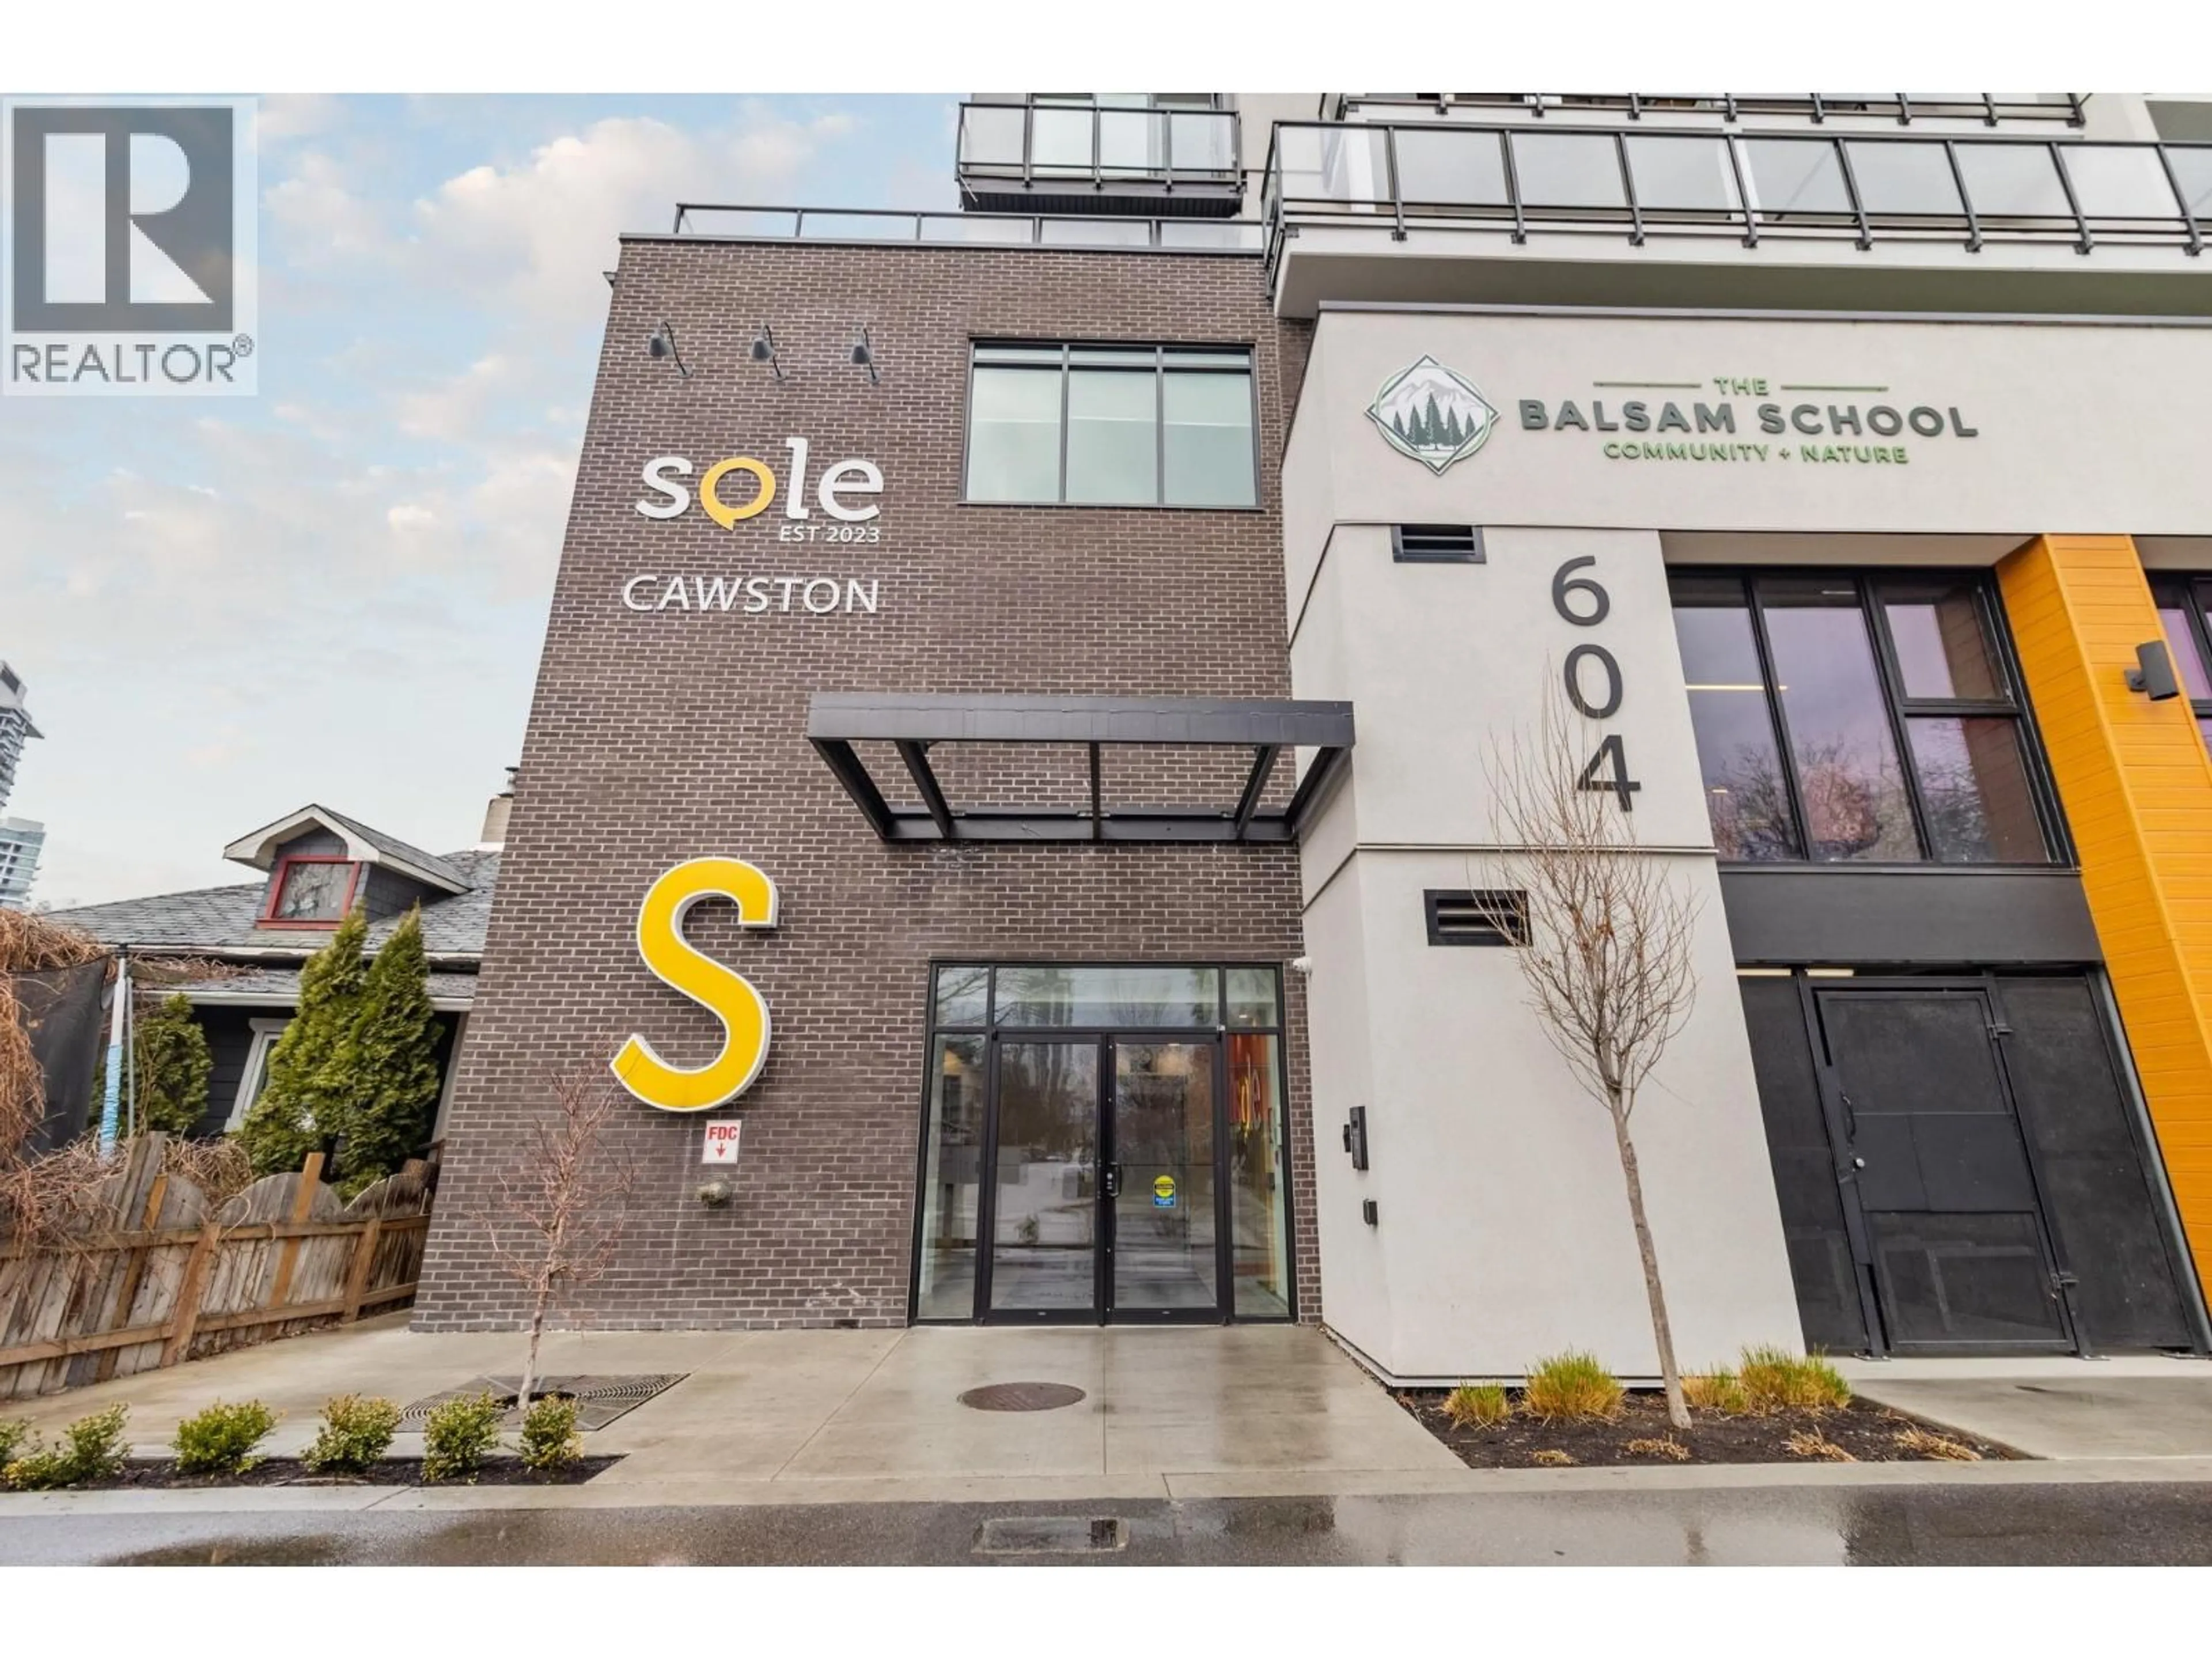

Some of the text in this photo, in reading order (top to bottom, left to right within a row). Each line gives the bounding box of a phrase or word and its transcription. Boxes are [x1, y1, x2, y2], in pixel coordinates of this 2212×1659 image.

[1713, 377, 1770, 396] THE
[1519, 399, 1979, 438] BALSAM SCHOOL
[1603, 442, 1769, 461] COMMUNITY
[1800, 445, 1909, 464] NATURE
[635, 437, 884, 532] sole
[780, 525, 880, 543] EST 2023
[623, 575, 879, 614] CAWSTON
[609, 856, 779, 1113] S
[708, 1126, 738, 1141] FDC
